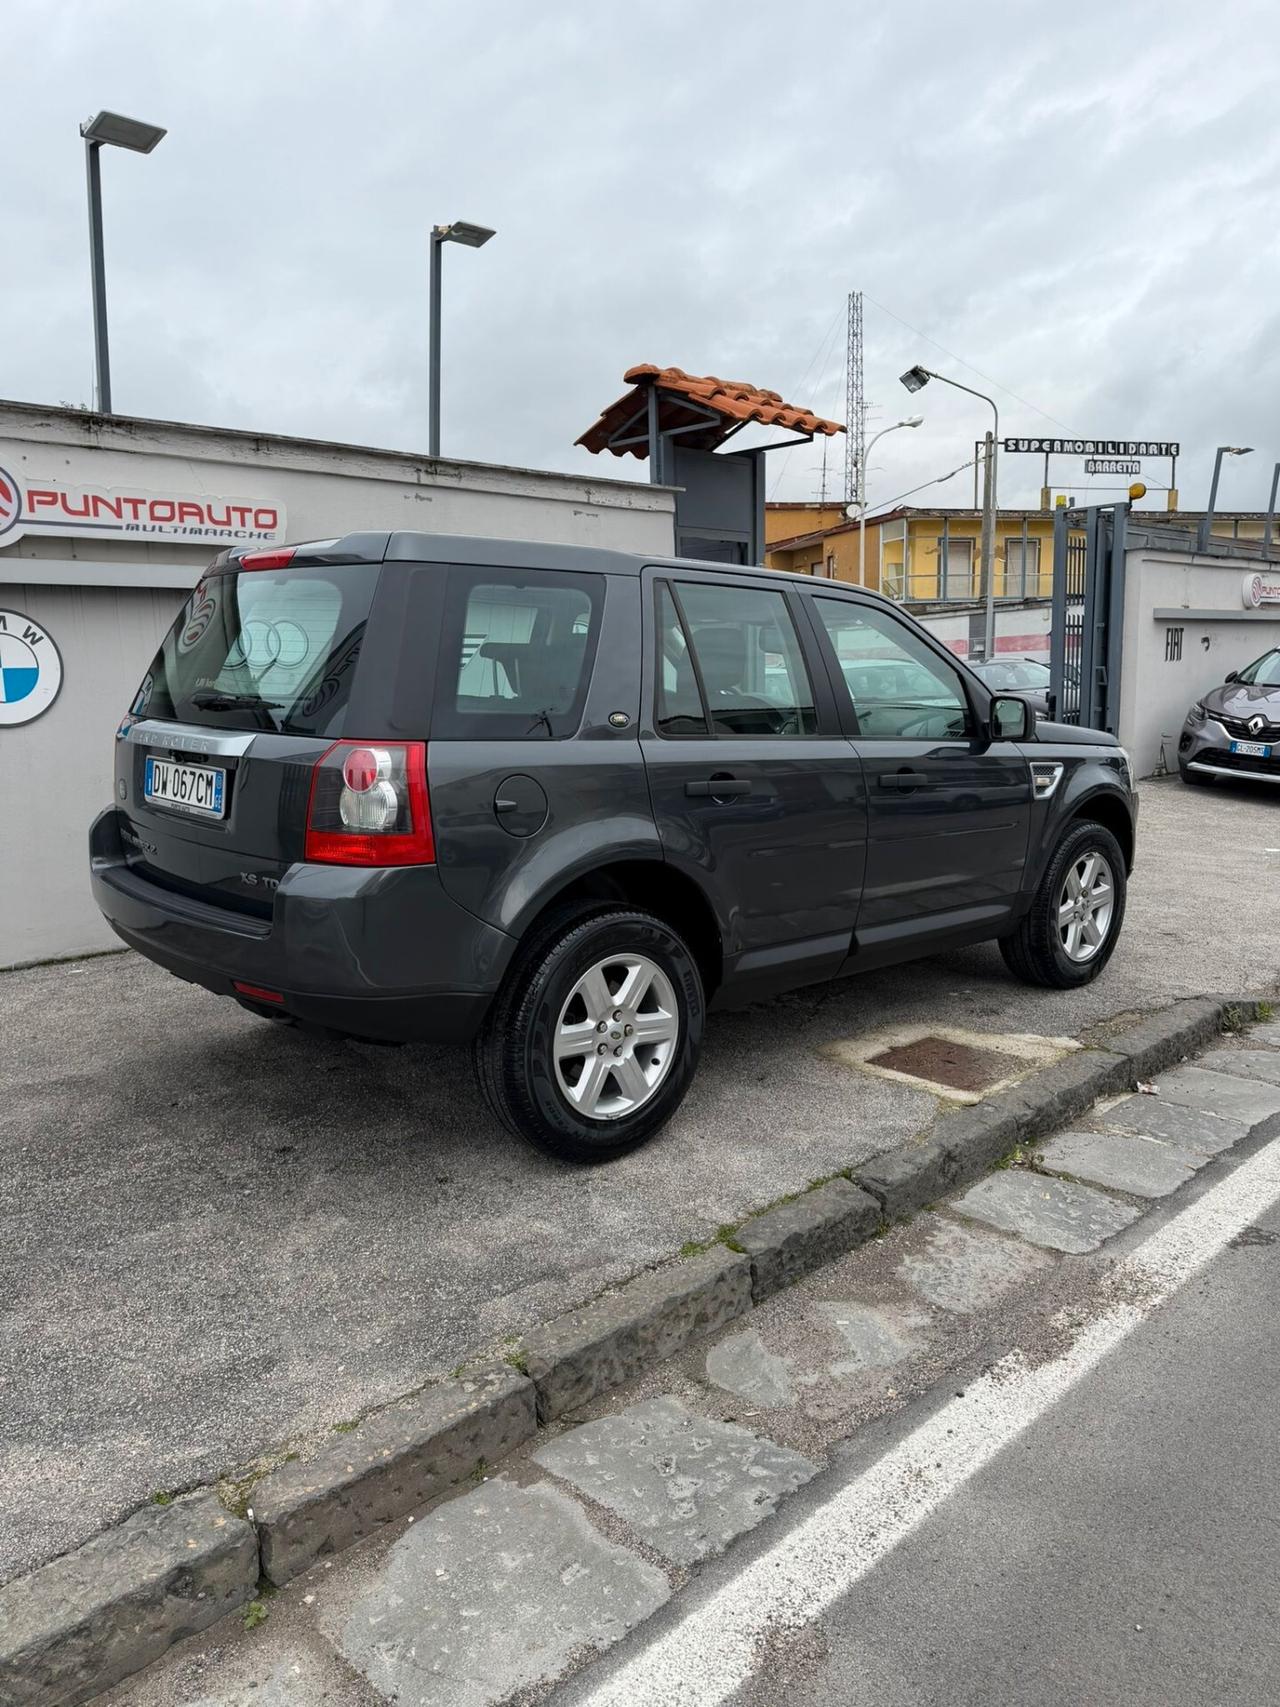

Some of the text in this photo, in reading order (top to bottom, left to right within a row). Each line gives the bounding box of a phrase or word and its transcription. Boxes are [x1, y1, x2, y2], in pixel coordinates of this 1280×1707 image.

[1088, 461, 1140, 473] BARRETTA
[27, 490, 278, 529] PUNTOAUTO
[125, 523, 276, 540] MULTIMARCHE
[1165, 627, 1184, 661] FIAT
[154, 764, 169, 796] DW
[172, 768, 214, 806] 067CM
[240, 872, 258, 887] XS
